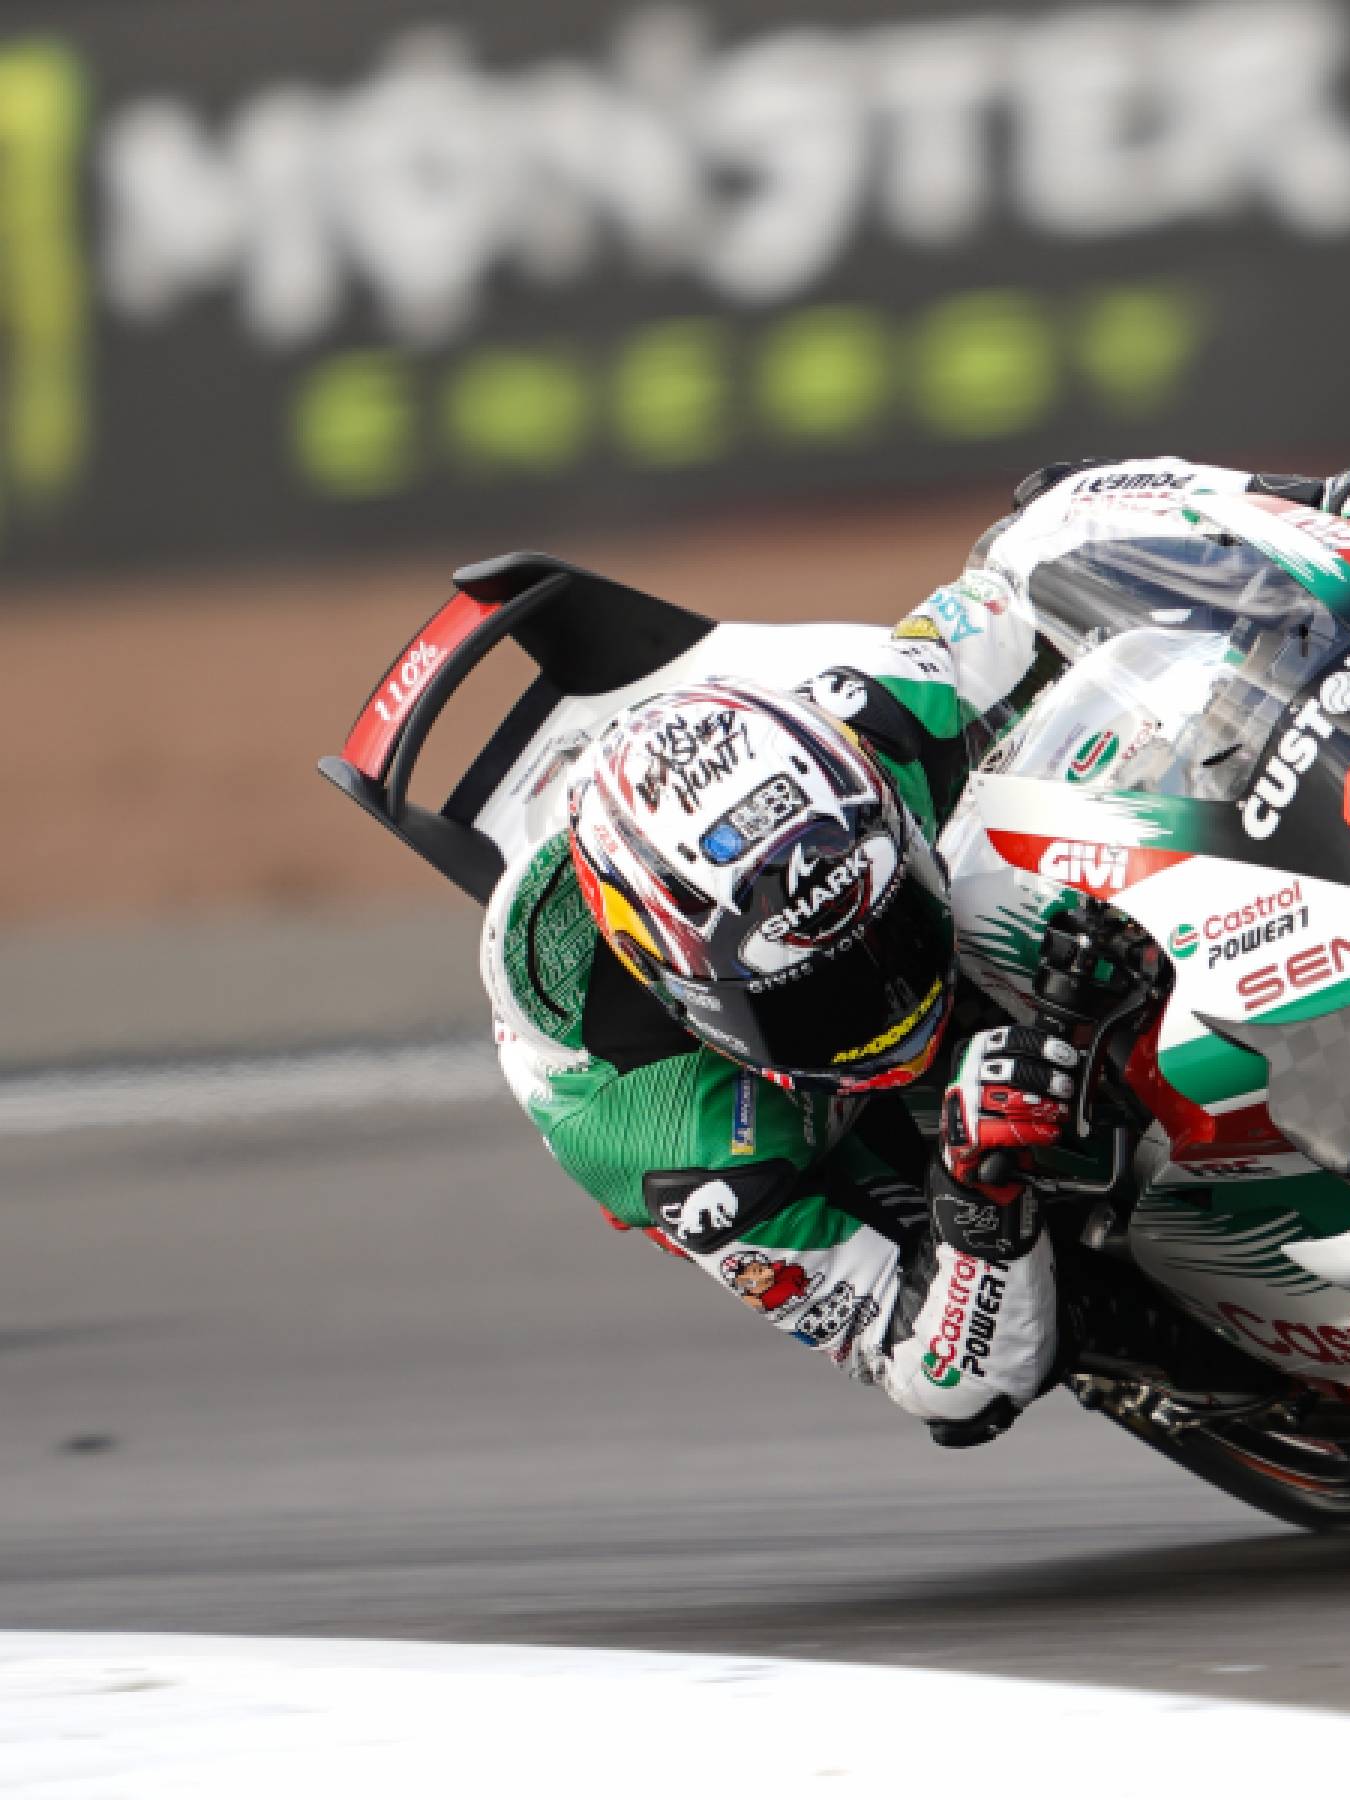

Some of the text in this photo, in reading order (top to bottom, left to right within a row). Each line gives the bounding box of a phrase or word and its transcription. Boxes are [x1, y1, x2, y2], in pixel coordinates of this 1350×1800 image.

[374, 639, 439, 722] 110%
[760, 846, 873, 940] SHARK
[1037, 842, 1129, 892] GIVI
[1203, 879, 1304, 942] Castrol
[1208, 908, 1311, 970] POWER1
